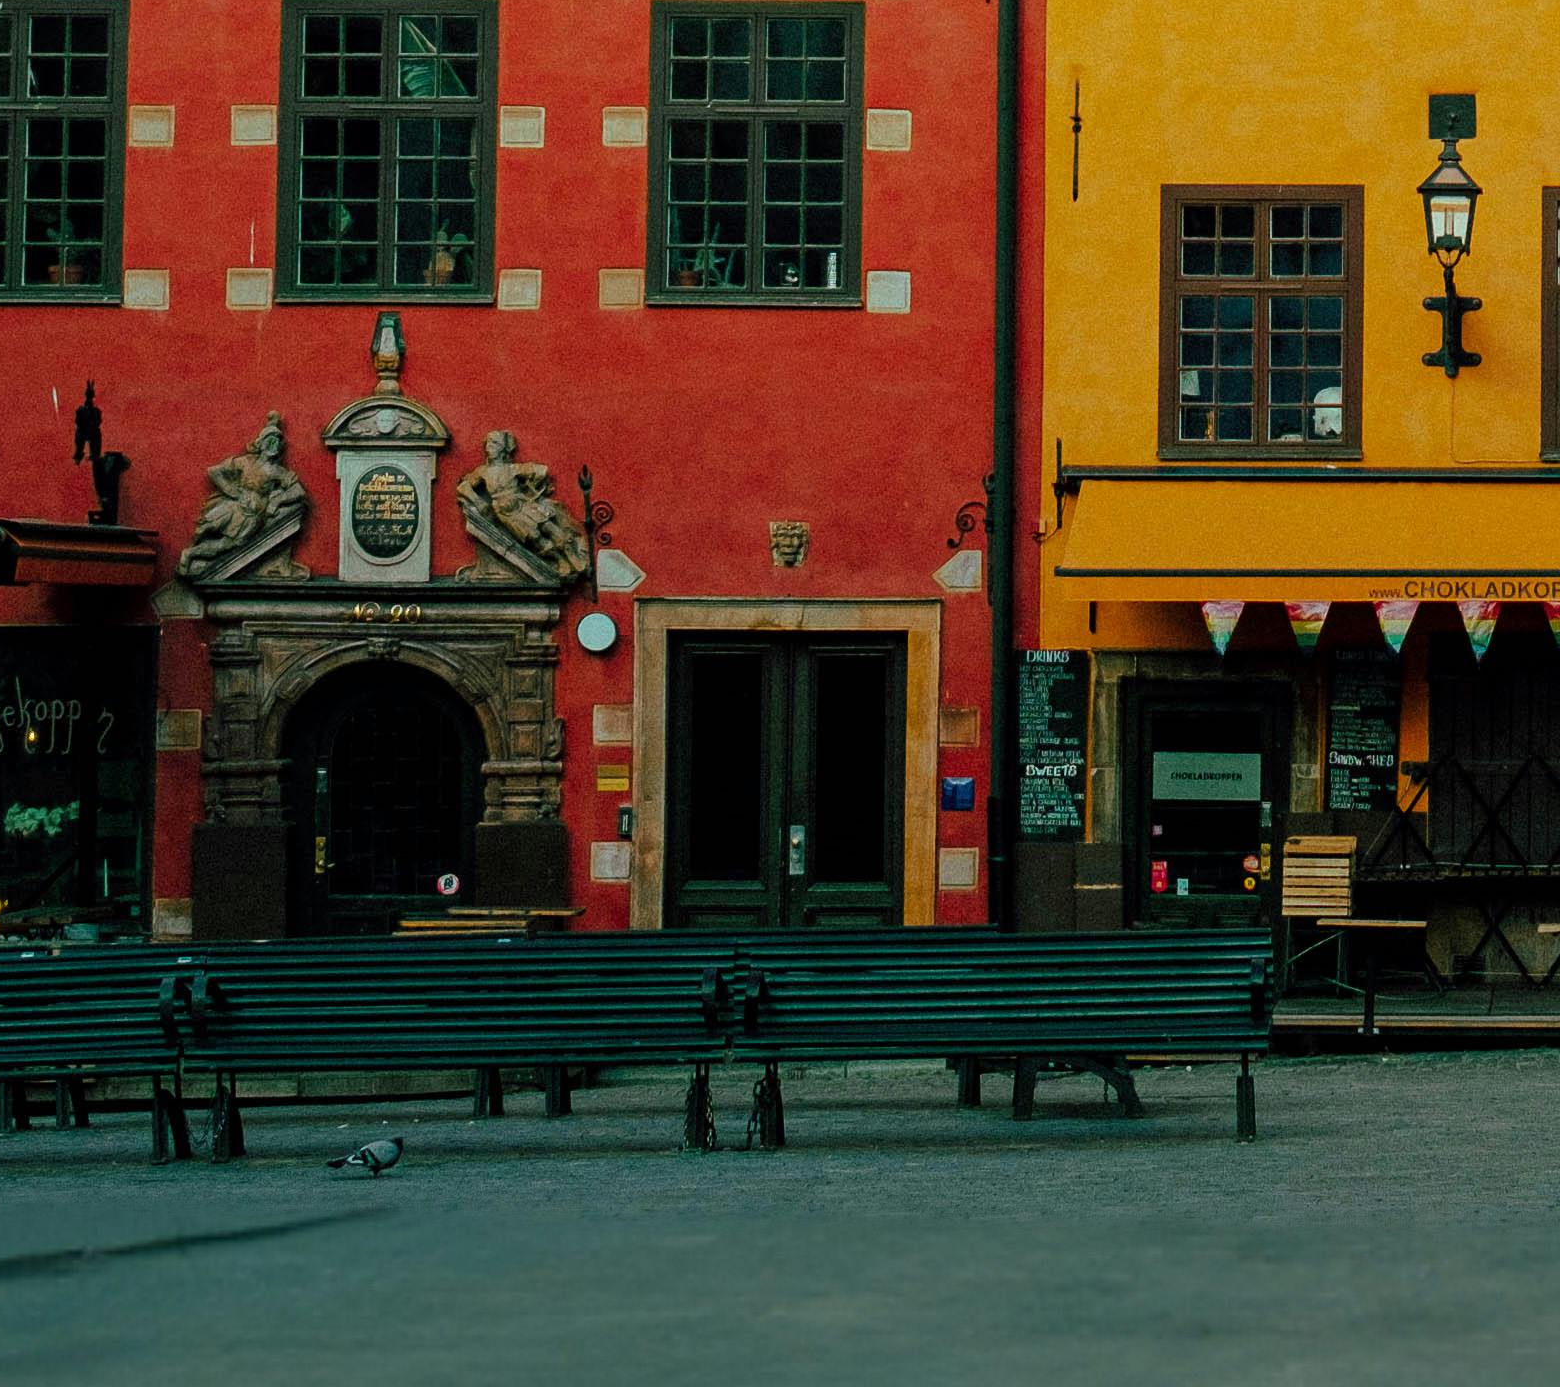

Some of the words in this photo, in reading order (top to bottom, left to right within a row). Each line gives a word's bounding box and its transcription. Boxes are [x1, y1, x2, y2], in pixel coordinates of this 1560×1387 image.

[389, 603, 421, 624] 20
[1025, 649, 1070, 664] DRINKS
[1025, 763, 1078, 777] SWEETS
[1170, 771, 1243, 782] CHOKLADKOPPEN
